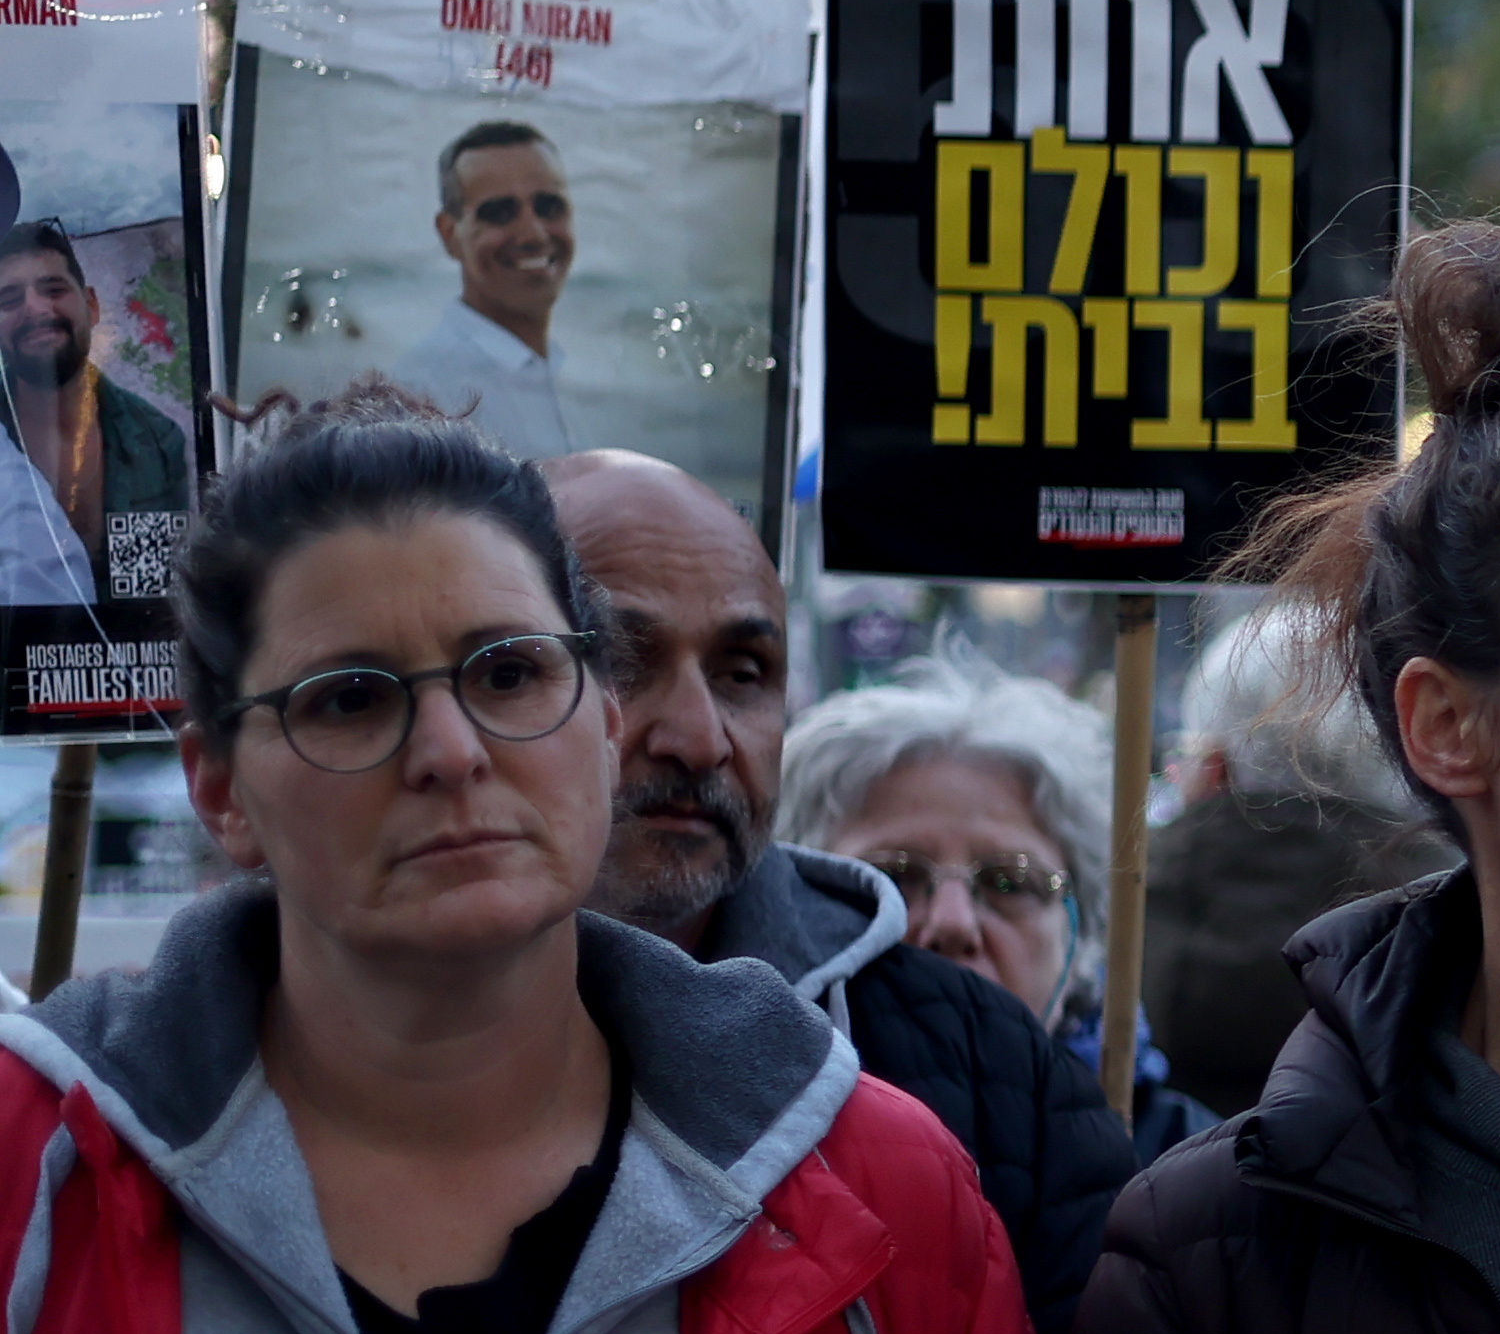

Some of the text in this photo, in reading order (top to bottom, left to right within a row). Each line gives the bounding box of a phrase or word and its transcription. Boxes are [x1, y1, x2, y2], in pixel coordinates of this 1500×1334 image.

[523, 0, 612, 47] MIRAN
[934, 125, 1296, 297] וכולם
[932, 293, 1297, 451] בבית!
[26, 642, 103, 668] HOSTAGES
[107, 642, 138, 666] AND
[28, 667, 126, 705] FAMILIES
